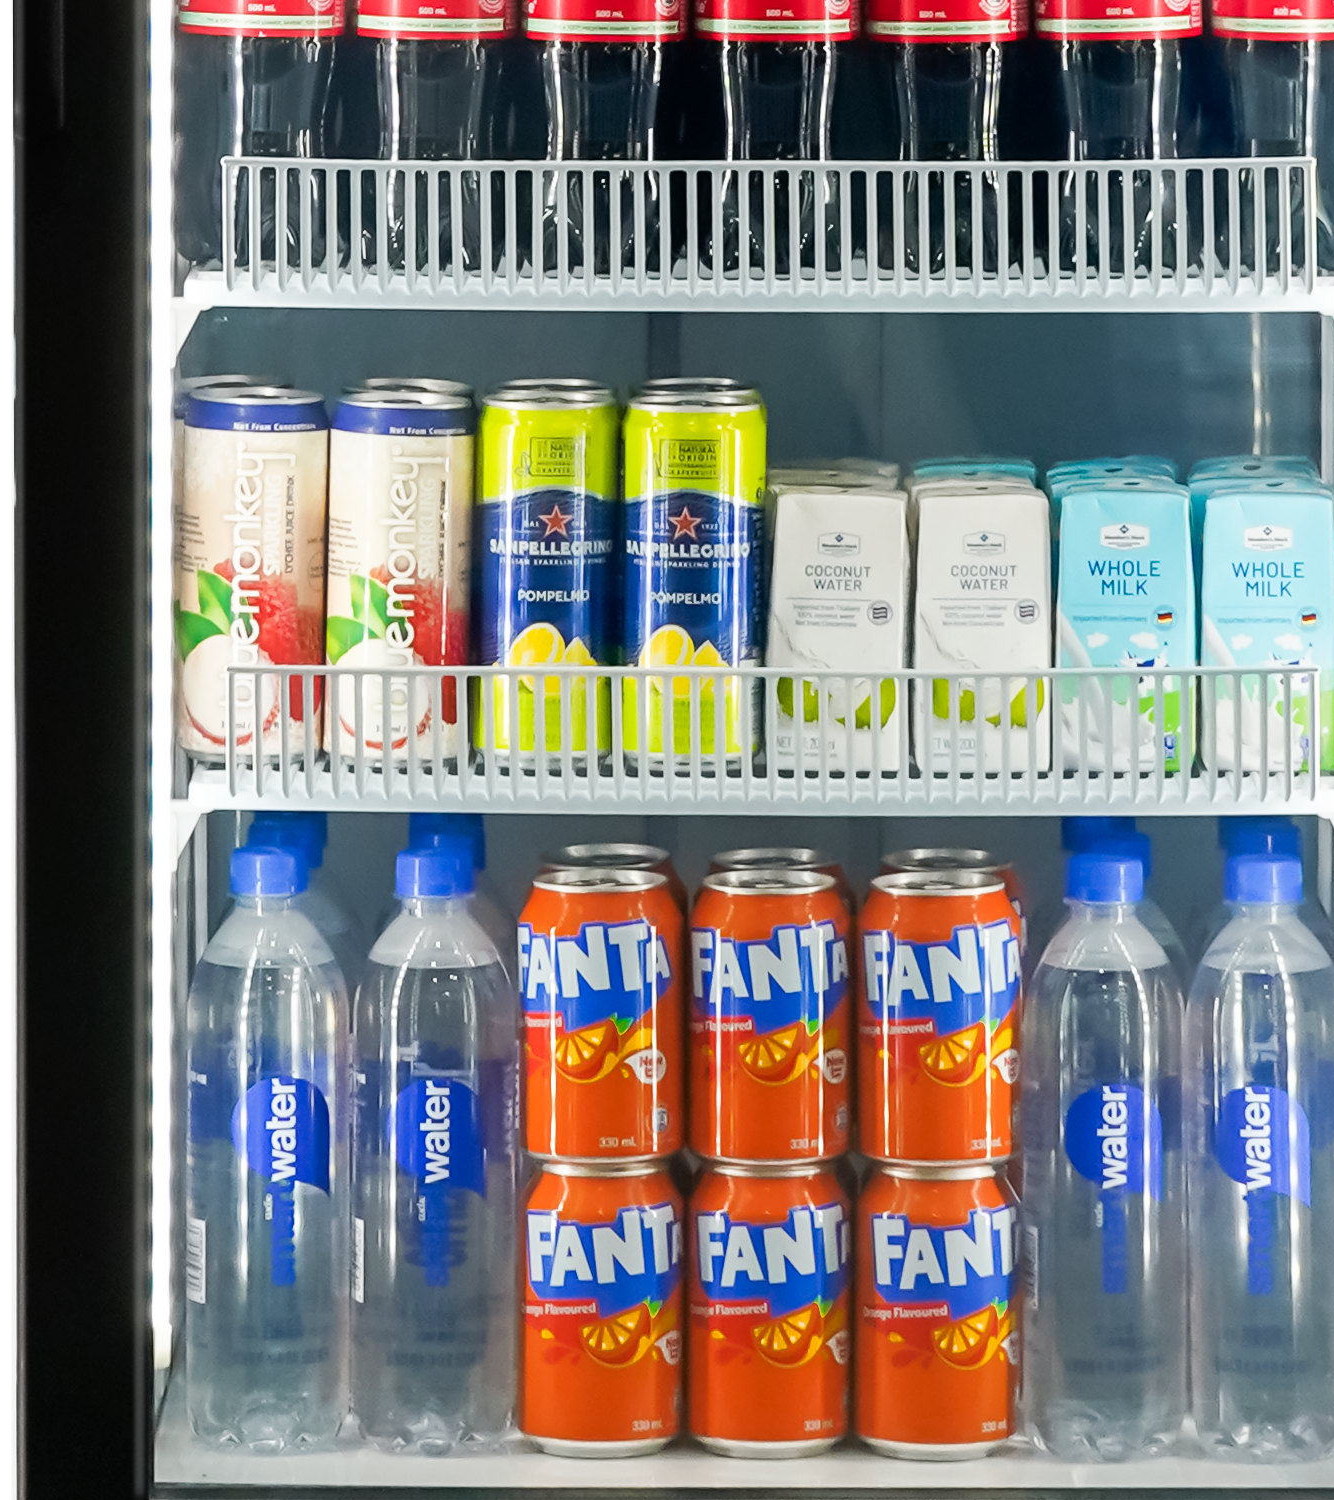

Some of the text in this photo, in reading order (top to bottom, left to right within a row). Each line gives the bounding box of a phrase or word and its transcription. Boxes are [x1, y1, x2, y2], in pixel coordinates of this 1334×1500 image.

[804, 564, 872, 578] COCONUT
[950, 564, 1017, 577] COCONUT
[1088, 560, 1161, 578] WHOLE
[1232, 562, 1305, 579] WHOLE
[814, 579, 862, 592] WATER
[959, 578, 1008, 591] WATER
[1101, 579, 1148, 596] MILK
[1245, 581, 1293, 598] MILK
[517, 588, 590, 603] POMPELMO
[649, 590, 722, 605] POMPELMO
[691, 923, 849, 1004] FANTA
[265, 1077, 297, 1182] water
[419, 1080, 451, 1184] water
[1096, 1085, 1128, 1190] water
[1240, 1086, 1272, 1190] water
[545, 1303, 597, 1315] Flavoured
[894, 1305, 948, 1318] Flavoured
